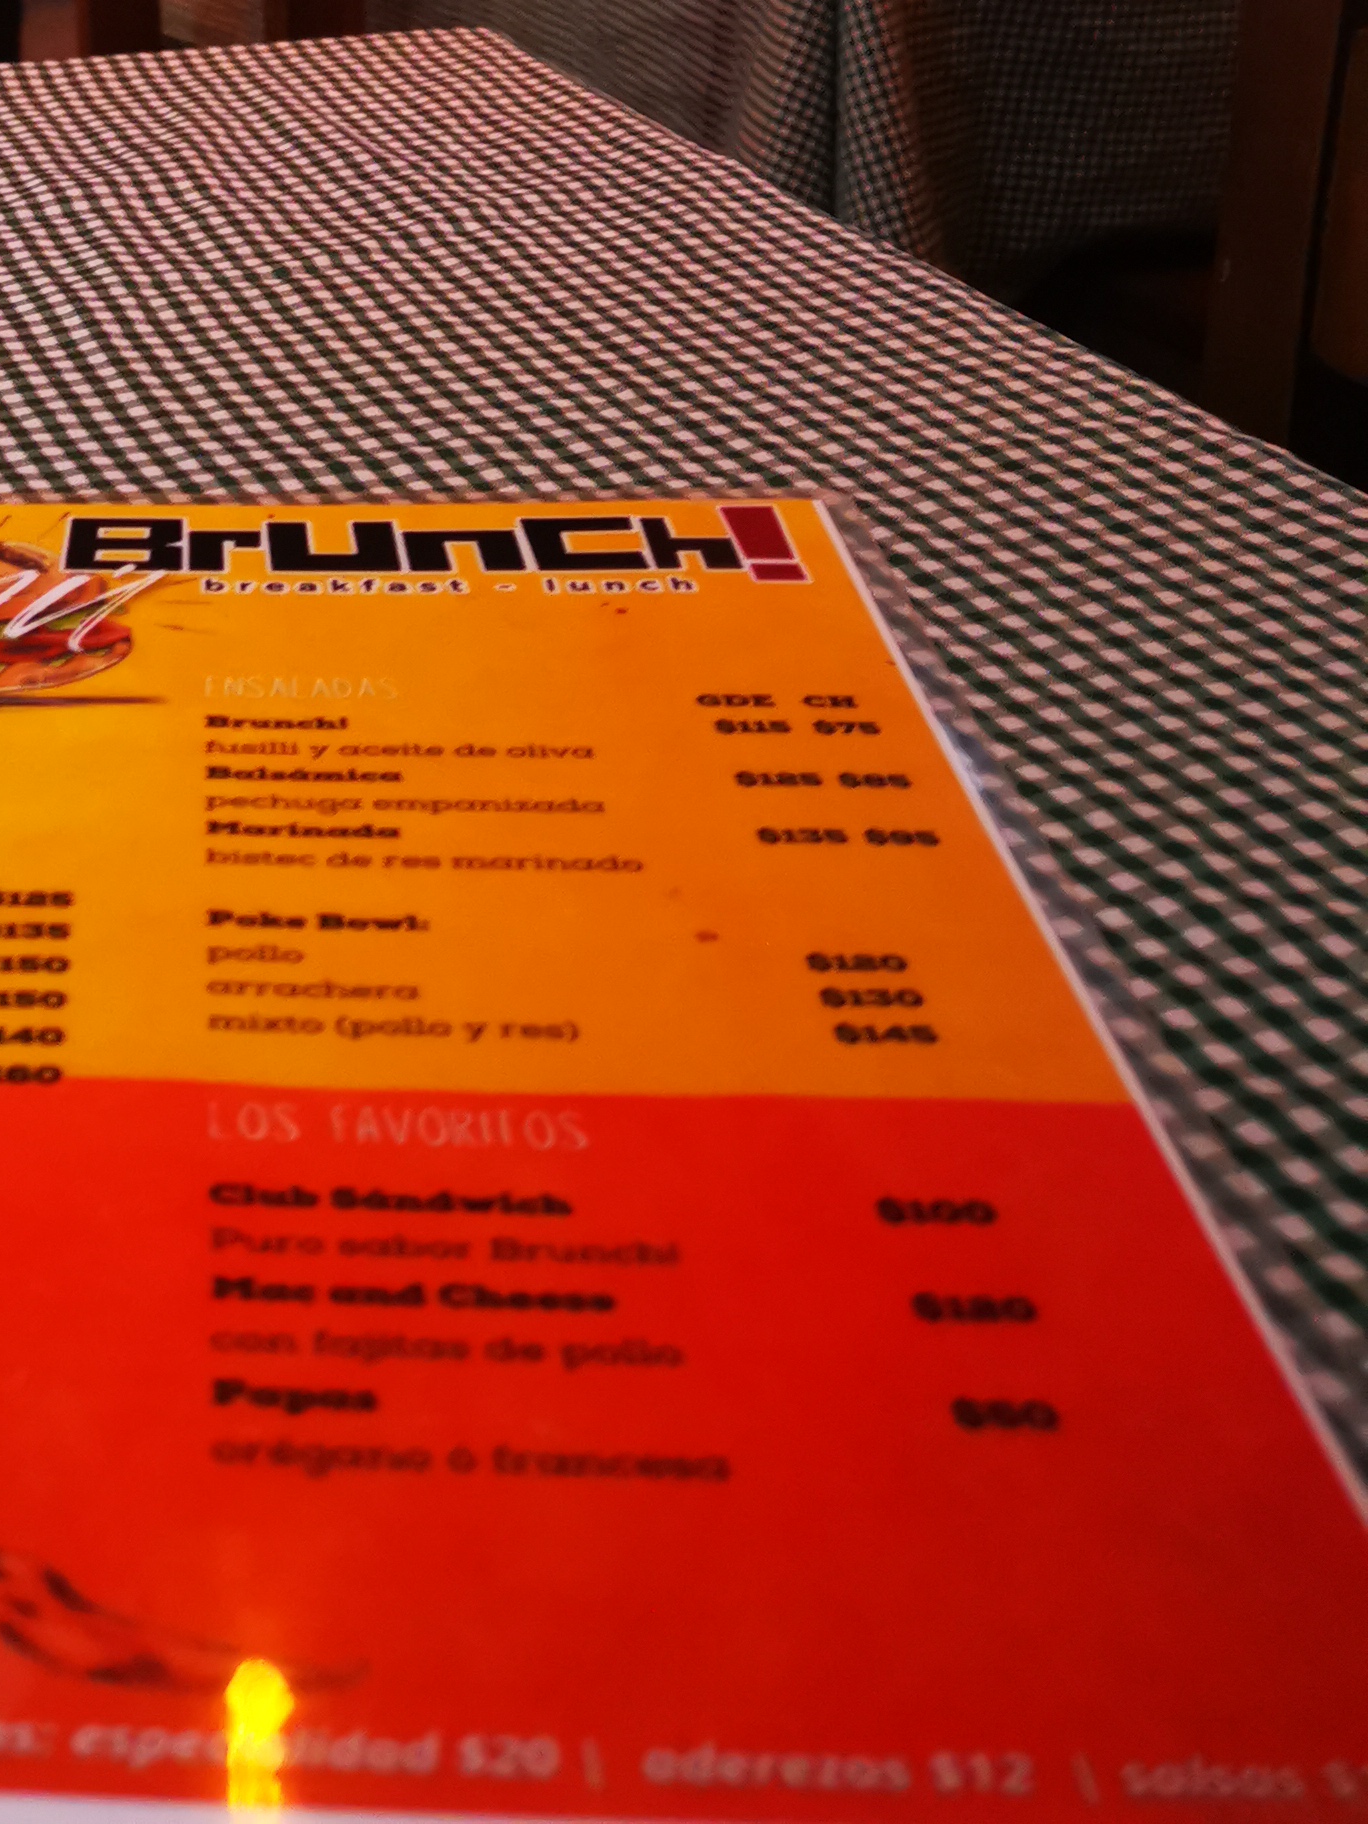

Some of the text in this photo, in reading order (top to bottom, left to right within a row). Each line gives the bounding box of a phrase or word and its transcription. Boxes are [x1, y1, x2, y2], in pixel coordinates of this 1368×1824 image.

[203, 576, 469, 597] breakfast
[544, 576, 699, 595] lunch
[458, 741, 496, 759] de
[506, 742, 595, 759] oliva
[204, 792, 362, 816] pechuga
[325, 849, 369, 870] de
[380, 854, 441, 871] res
[207, 942, 304, 967] pollo
